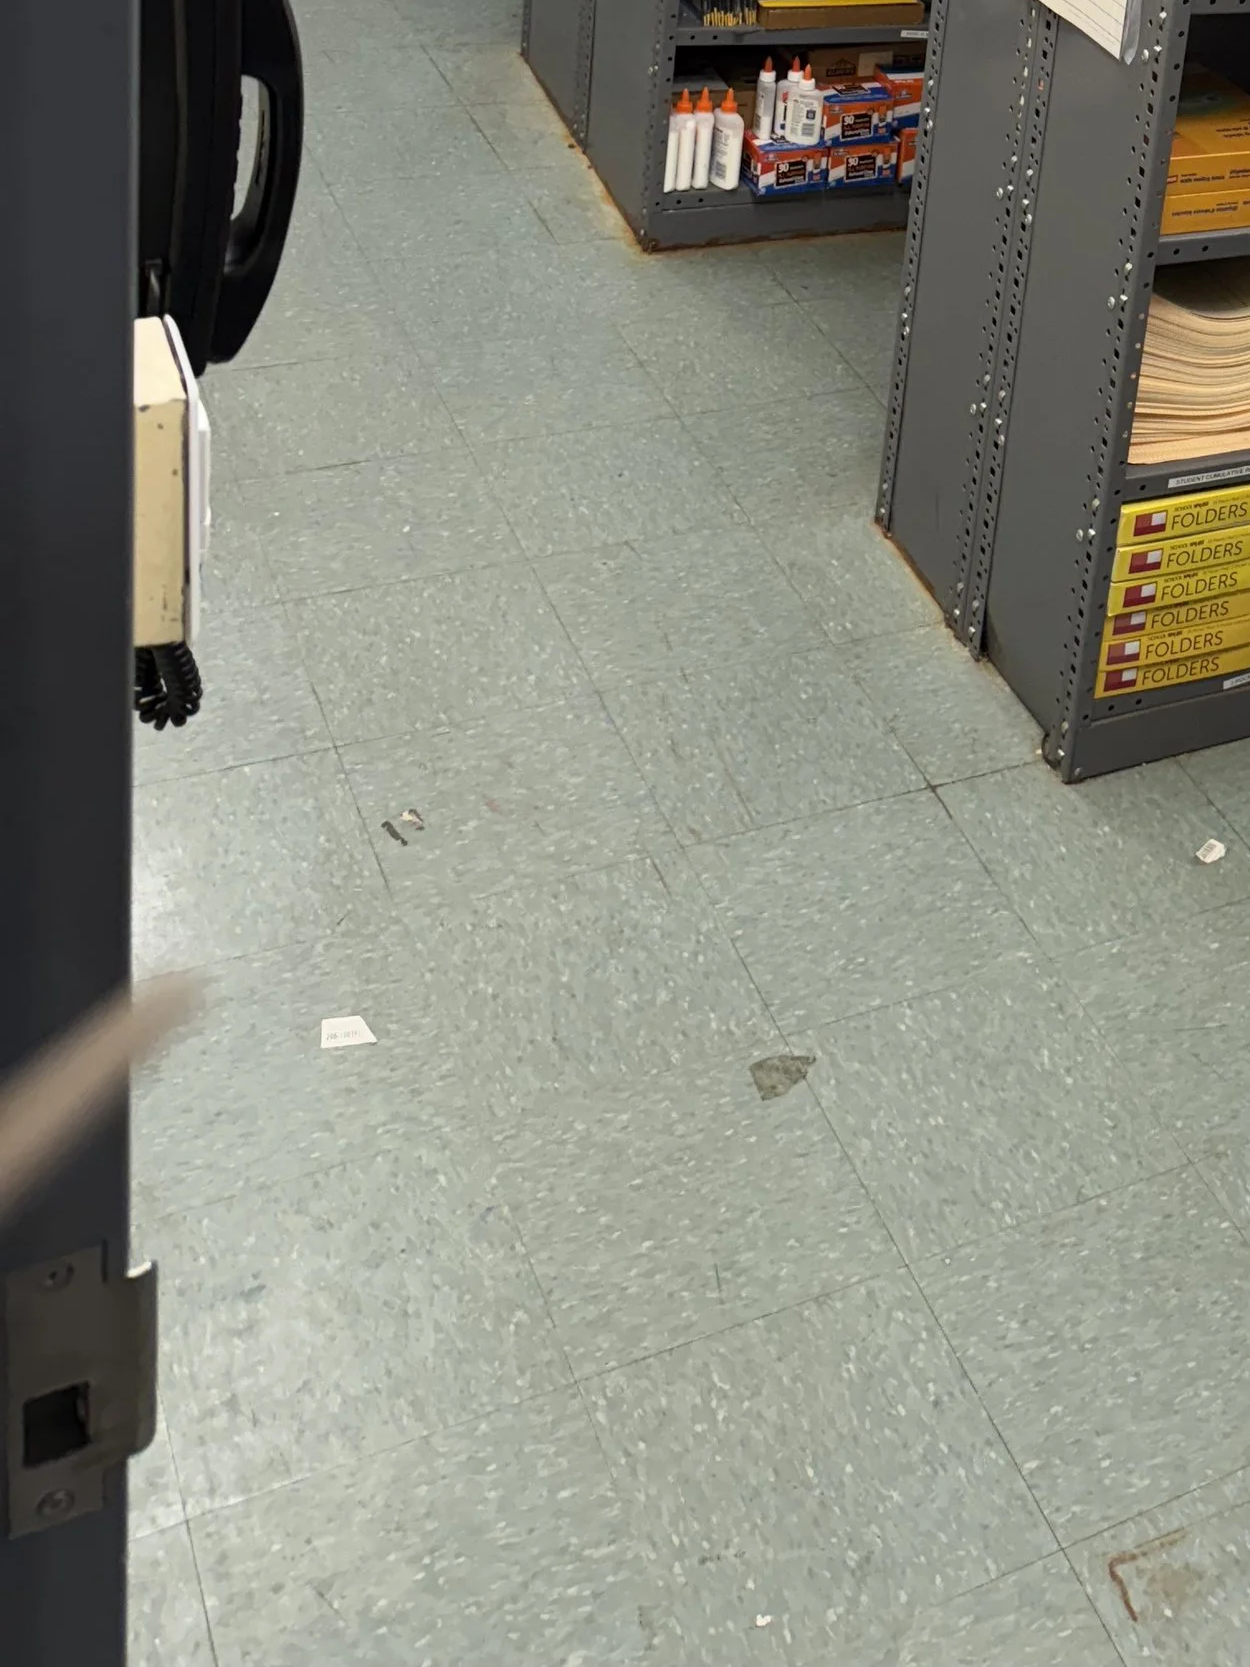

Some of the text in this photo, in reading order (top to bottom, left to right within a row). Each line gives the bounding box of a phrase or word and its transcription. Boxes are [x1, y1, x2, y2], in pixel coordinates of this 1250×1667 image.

[1171, 502, 1248, 530] FOLDERS
[1167, 541, 1243, 568] FOLDERS
[1161, 572, 1238, 600] FOLDERS
